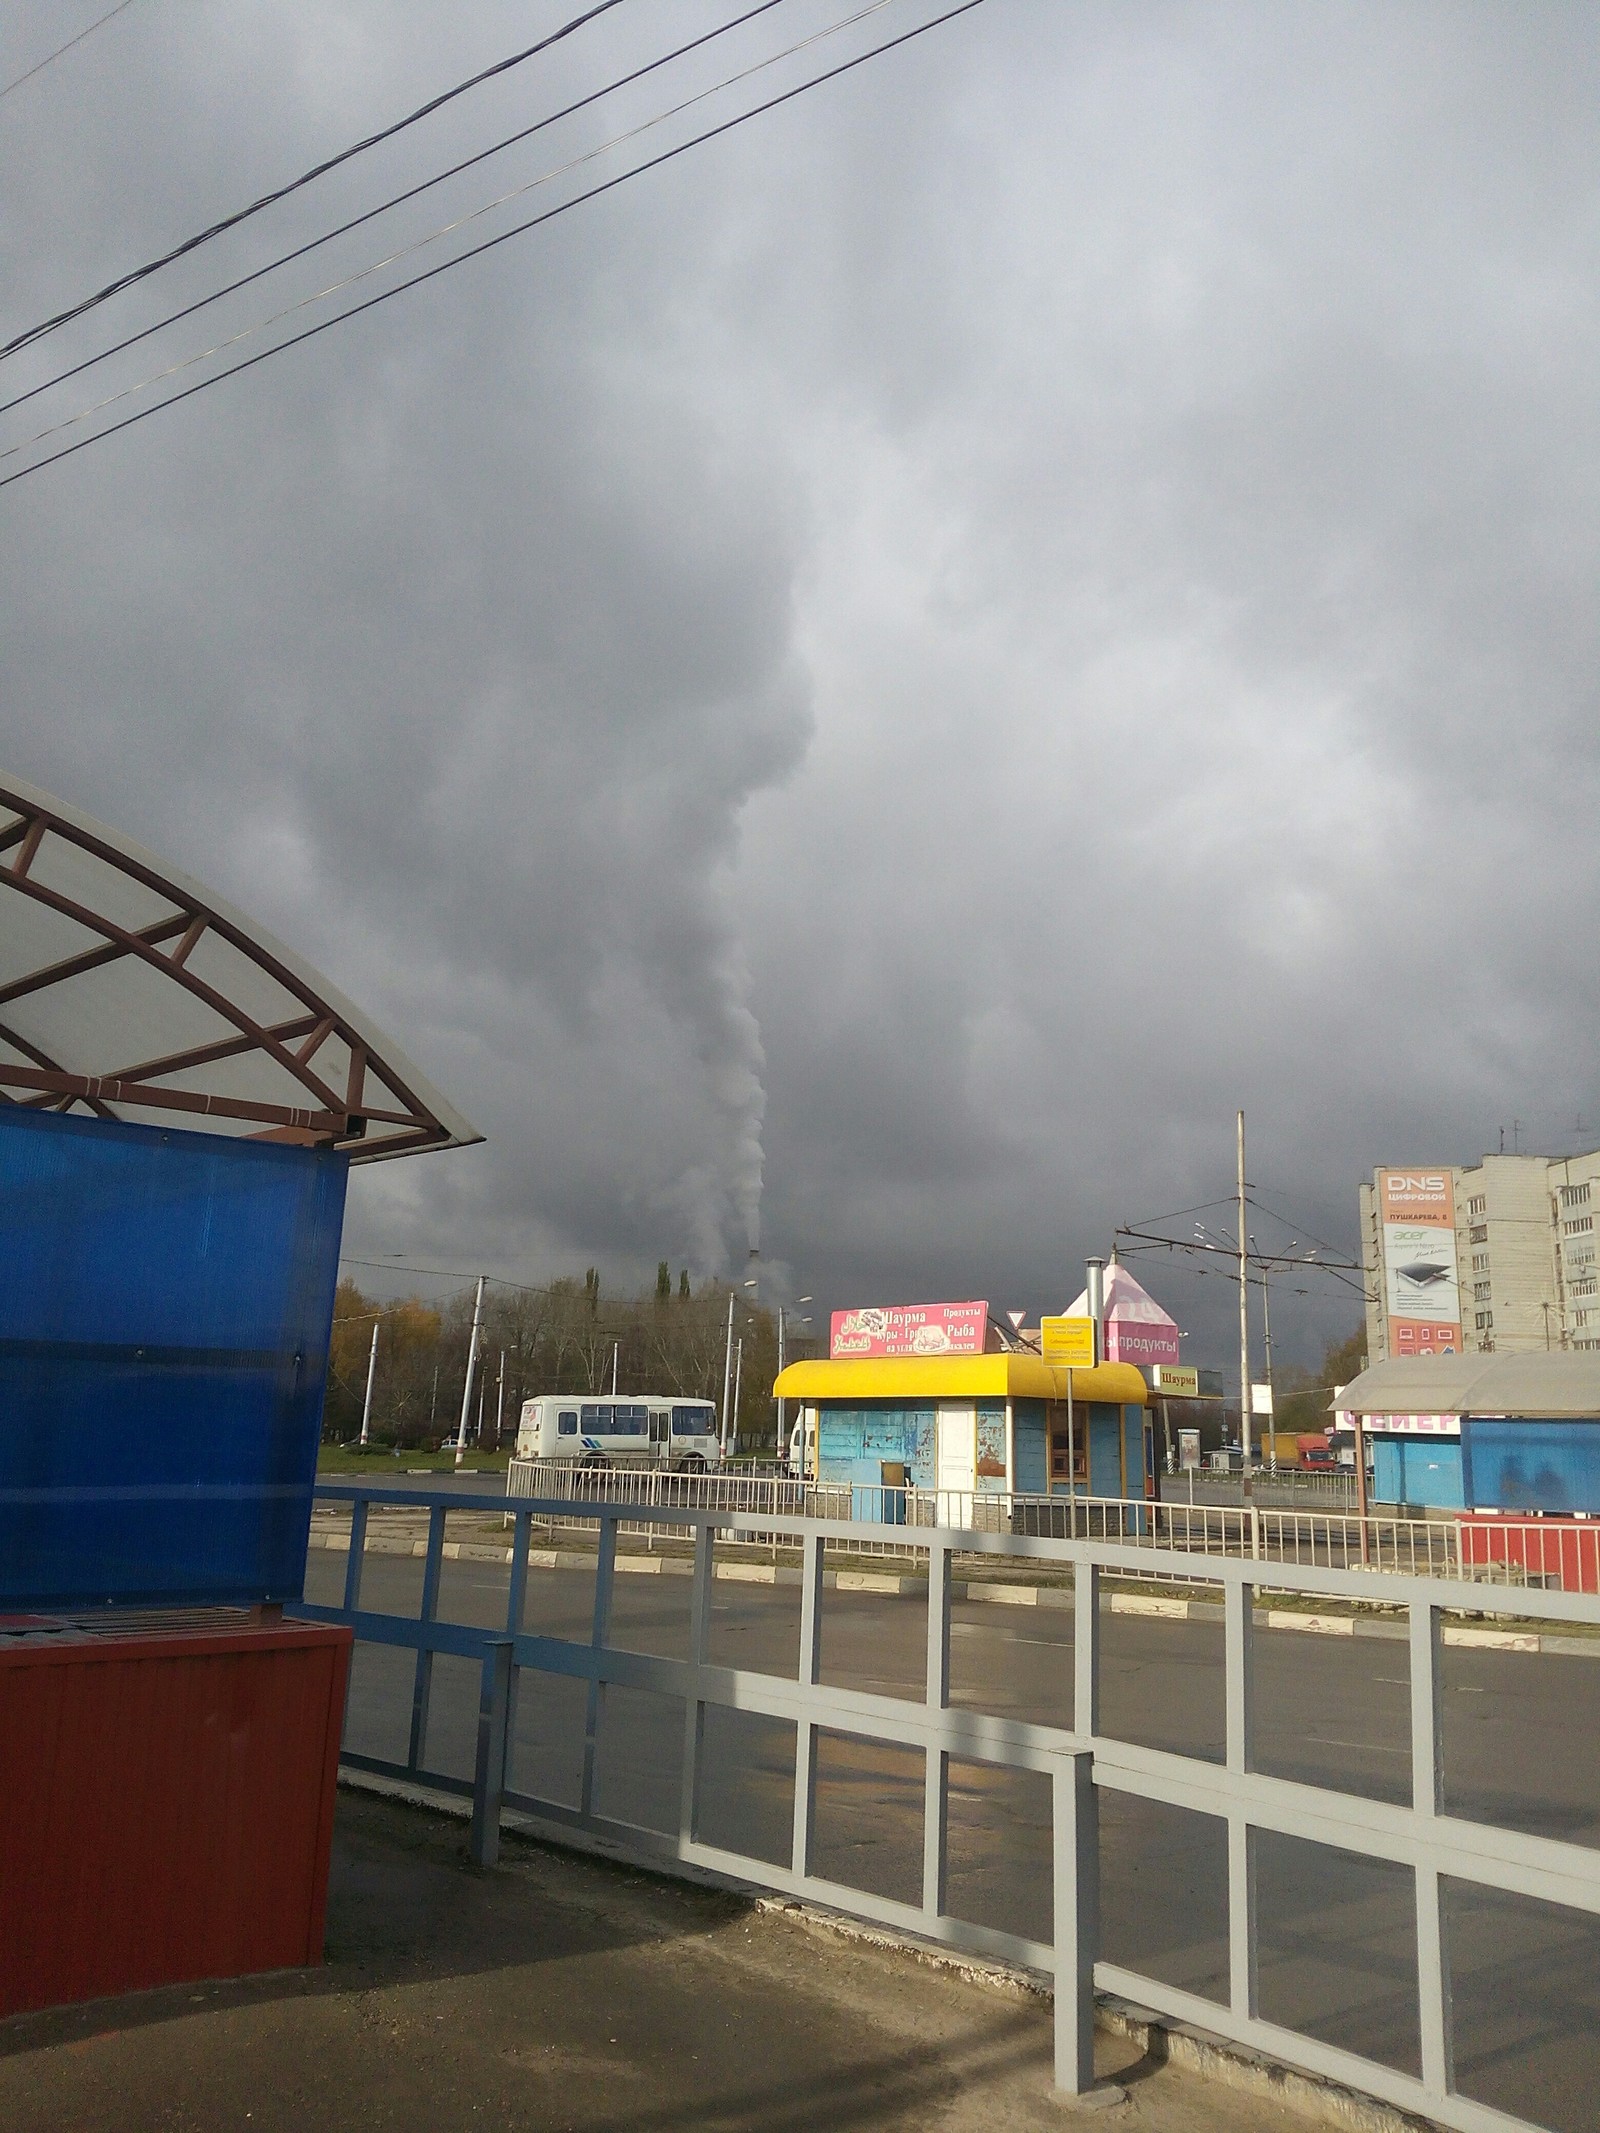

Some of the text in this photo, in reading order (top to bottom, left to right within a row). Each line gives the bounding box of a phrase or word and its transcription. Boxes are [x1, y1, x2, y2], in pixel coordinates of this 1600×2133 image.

[1387, 1176, 1445, 1191] DNS
[1388, 1192, 1446, 1202] ЦИФРОВОЙ
[1393, 1231, 1428, 1240] acer
[881, 1311, 926, 1327] Шаурма
[943, 1308, 981, 1319] Продукты
[876, 1329, 898, 1343] Куры
[947, 1324, 975, 1337] Рыба
[1118, 1336, 1176, 1353] продукты
[1161, 1372, 1196, 1387] Шаурма
